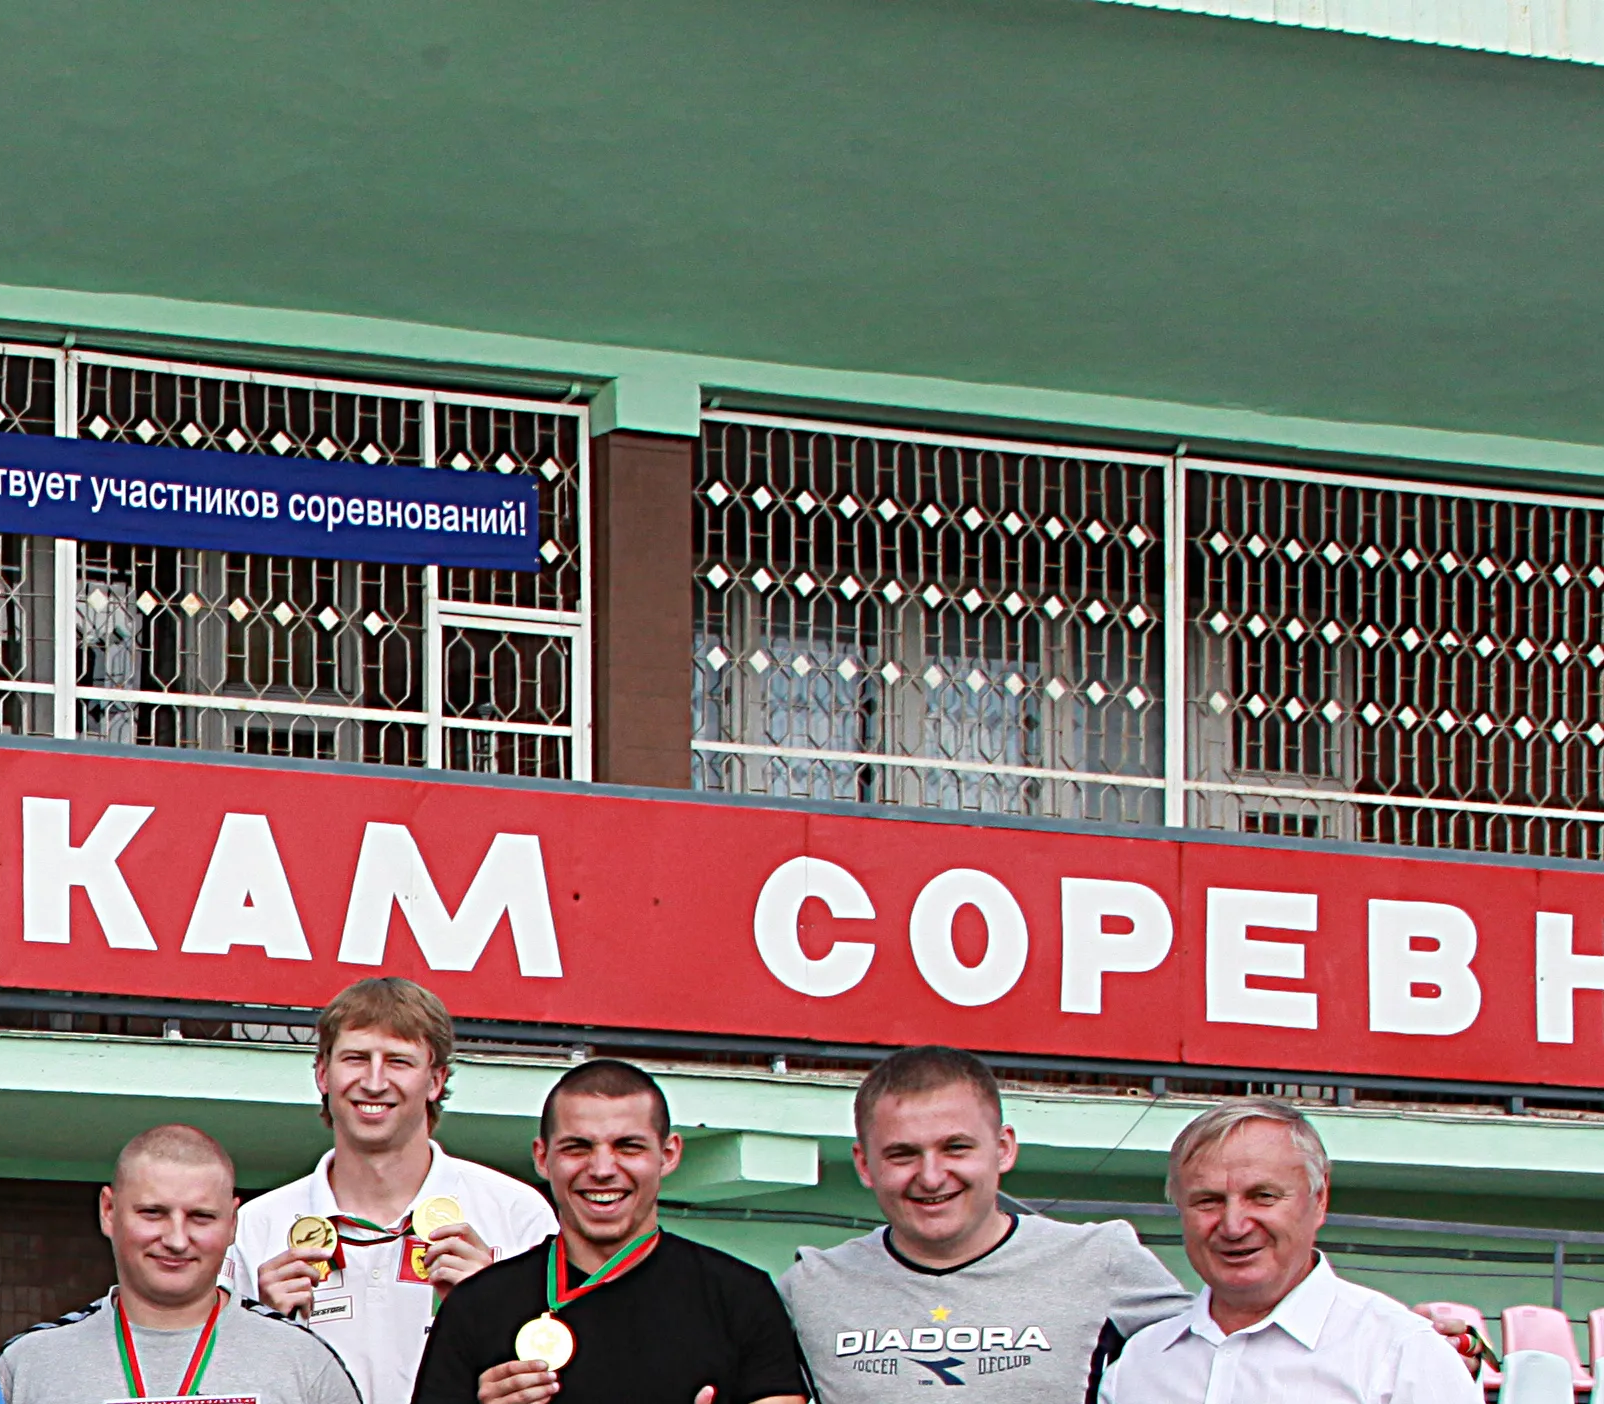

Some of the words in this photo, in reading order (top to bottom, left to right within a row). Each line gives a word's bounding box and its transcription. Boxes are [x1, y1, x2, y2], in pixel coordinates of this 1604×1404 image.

[90, 476, 279, 518] участников
[288, 494, 527, 537] соревнований!
[753, 855, 1604, 1044] СОРЕВН
[835, 1325, 1052, 1357] DIADORA
